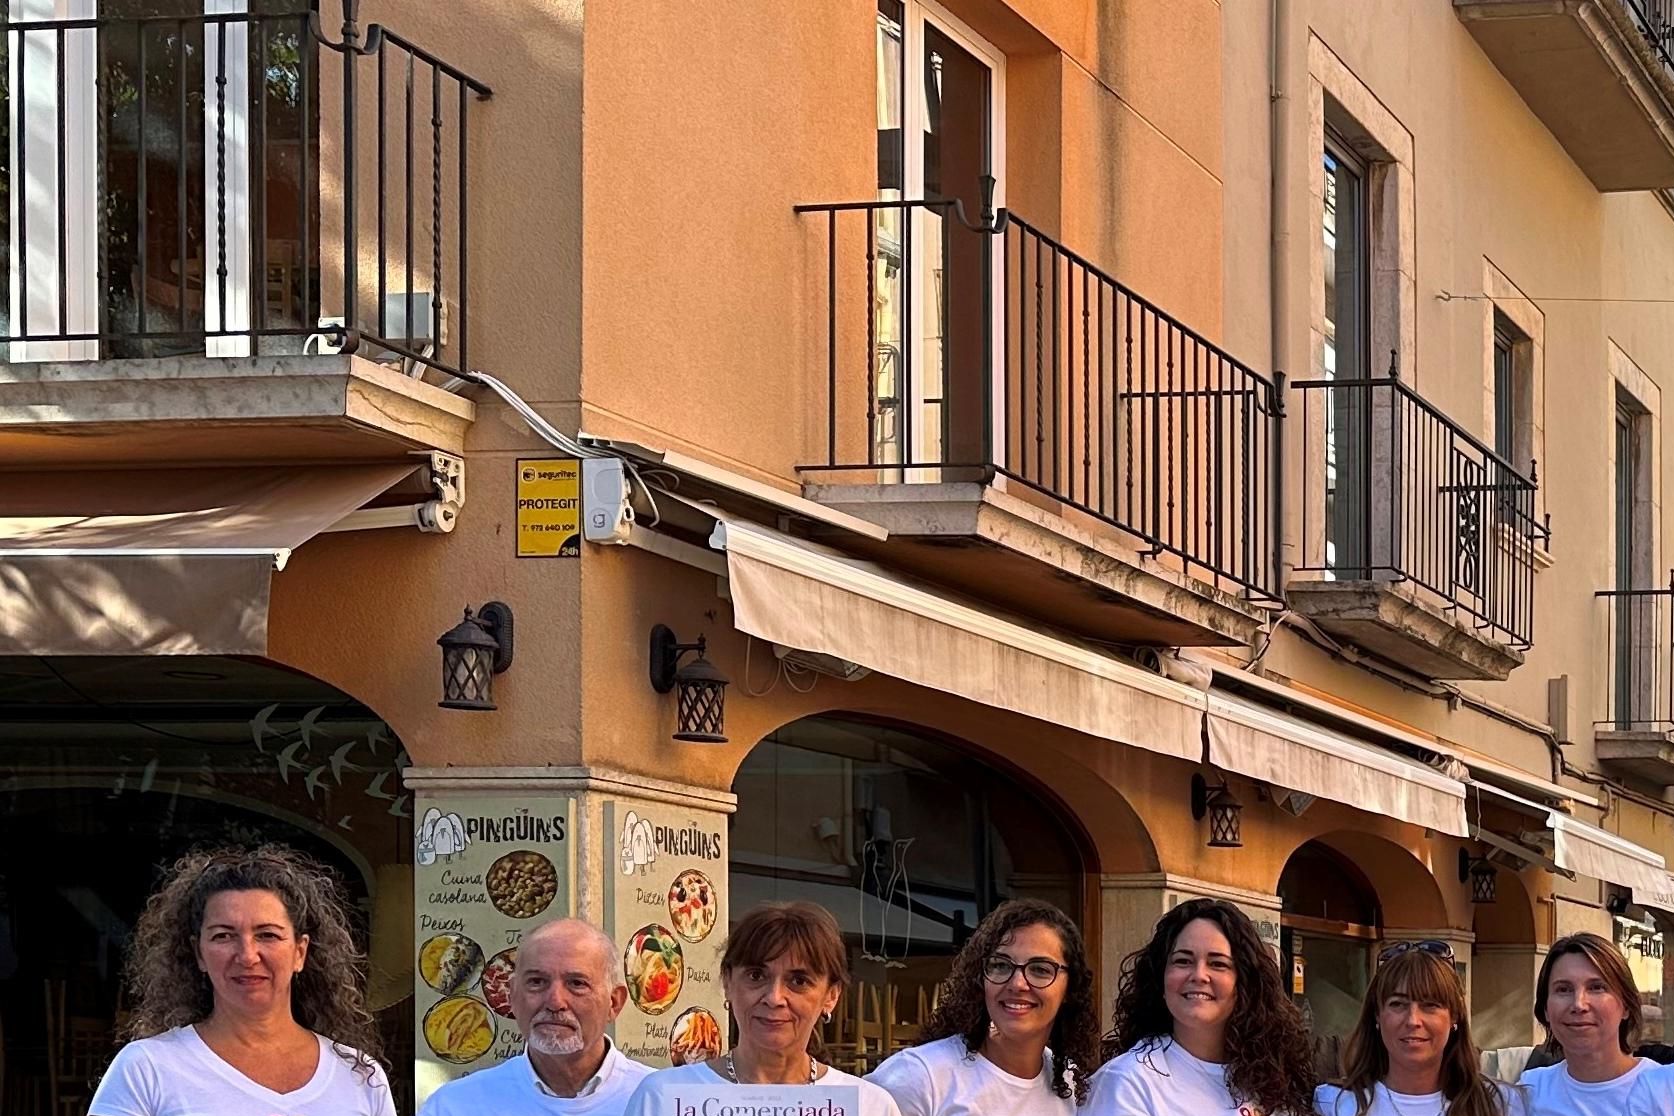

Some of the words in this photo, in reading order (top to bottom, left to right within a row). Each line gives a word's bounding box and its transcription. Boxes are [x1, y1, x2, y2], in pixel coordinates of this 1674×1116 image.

[518, 498, 579, 510] PROTEGIT
[440, 870, 483, 886] Cuina
[428, 888, 488, 905] casolana
[420, 914, 465, 931] Peixos
[686, 966, 712, 983] Pasta
[500, 1029, 523, 1044] Cre
